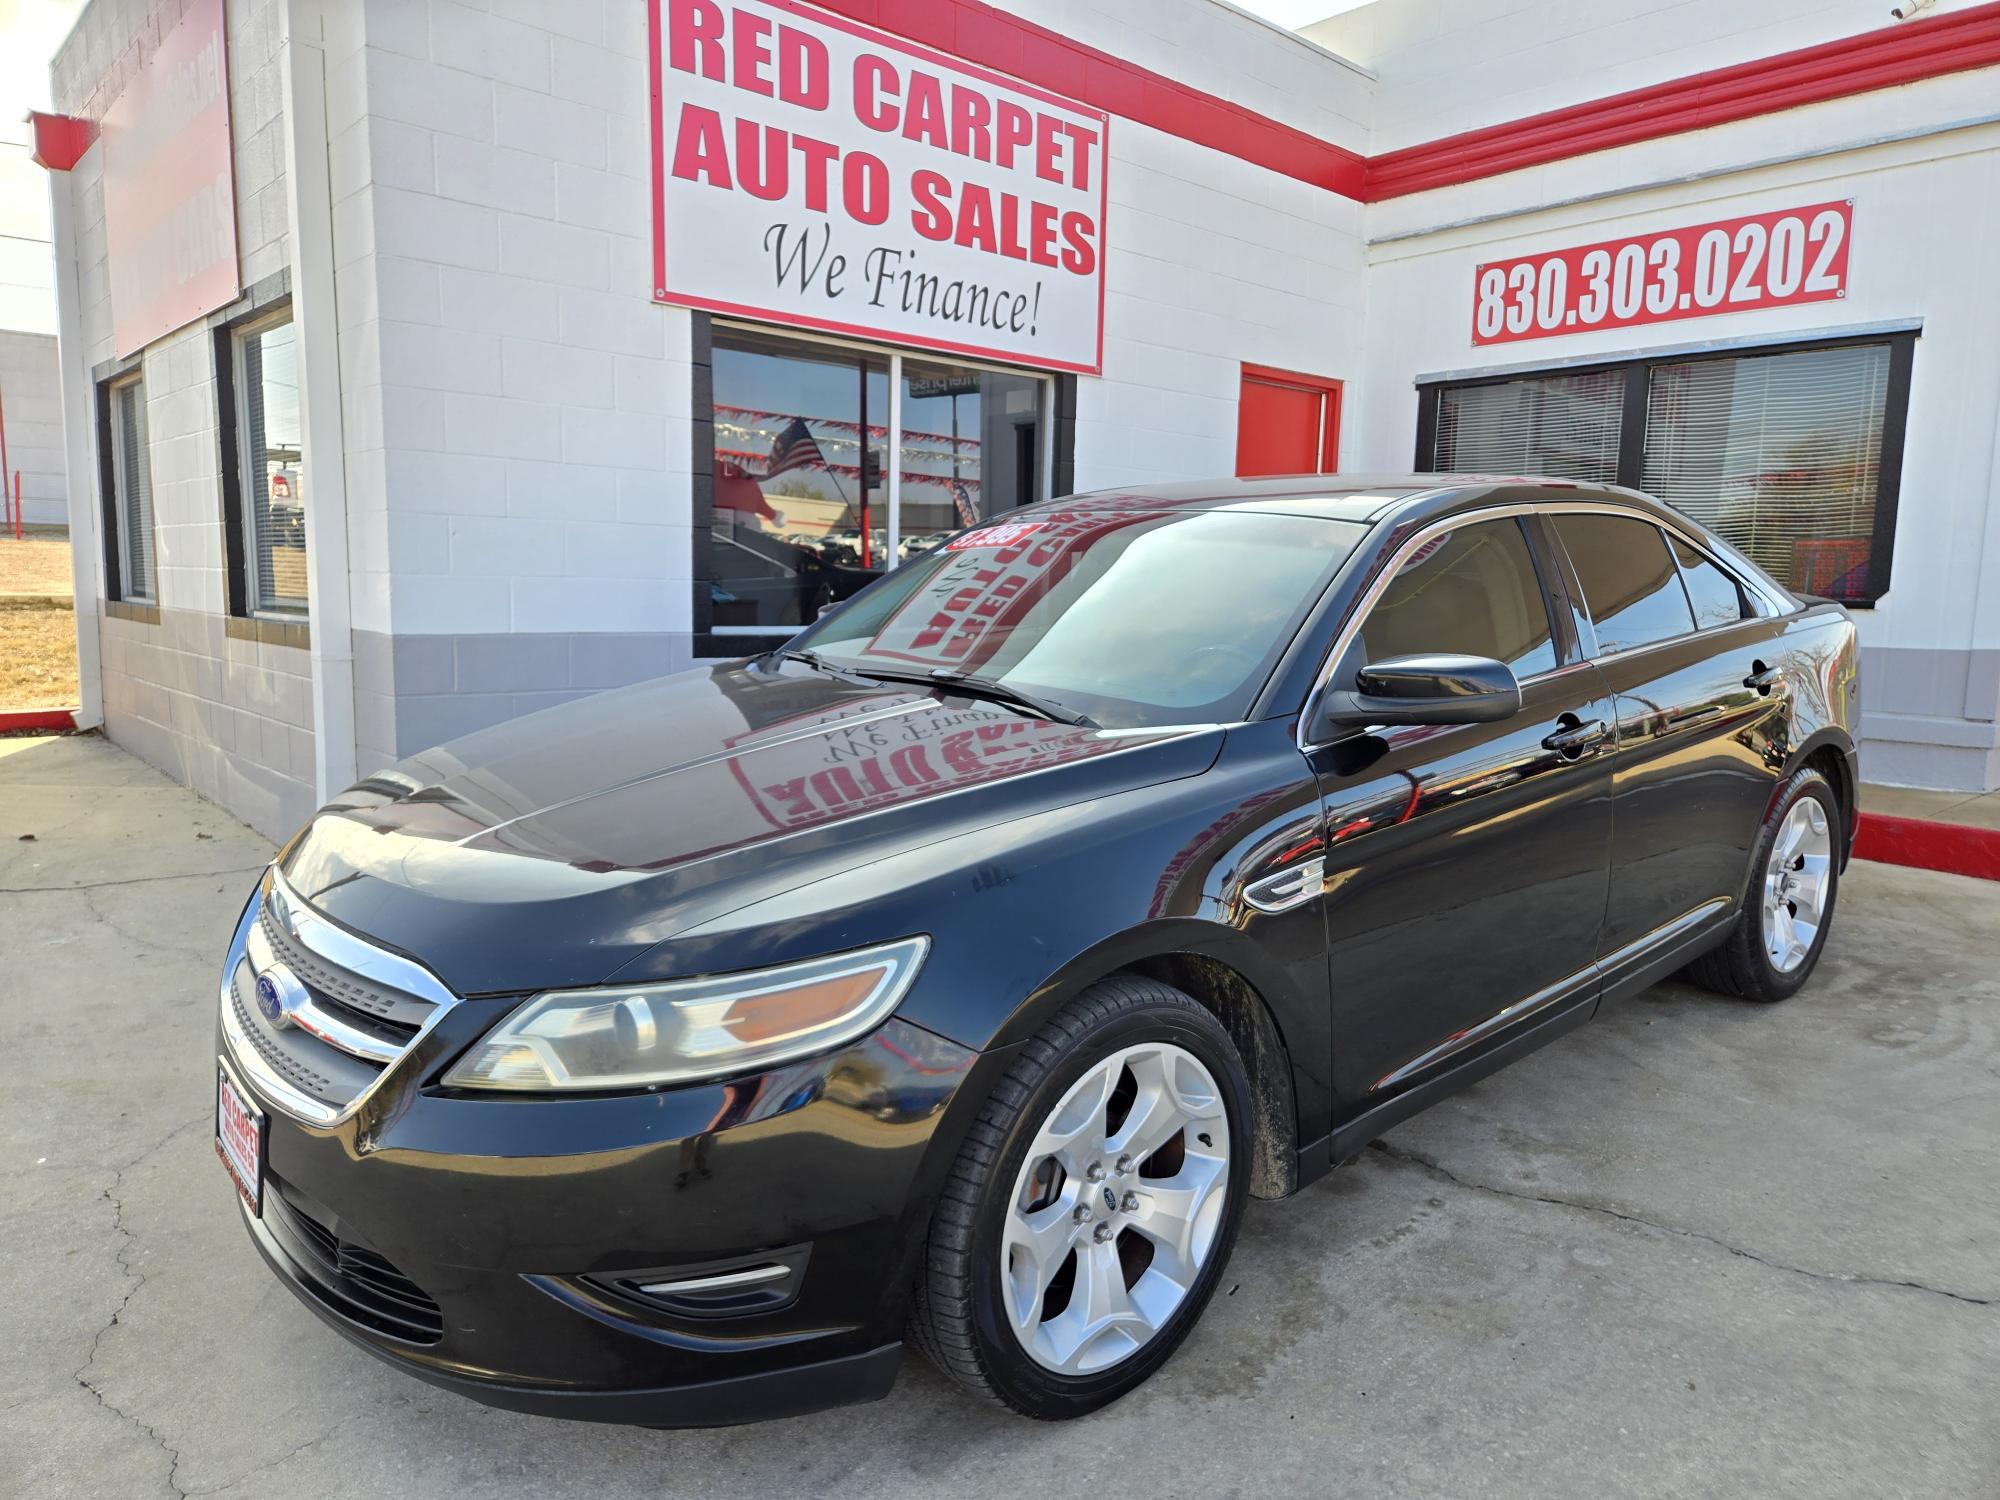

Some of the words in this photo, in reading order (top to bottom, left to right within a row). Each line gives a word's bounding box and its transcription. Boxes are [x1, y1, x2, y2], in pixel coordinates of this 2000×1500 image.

[669, 0, 829, 112] RED
[853, 53, 1098, 192] CARPET
[671, 102, 890, 226] AUTO
[910, 169, 1096, 276] SALES
[763, 222, 847, 299] We
[864, 247, 1041, 336] Finance!
[1477, 210, 1845, 338] 830.303.0202
